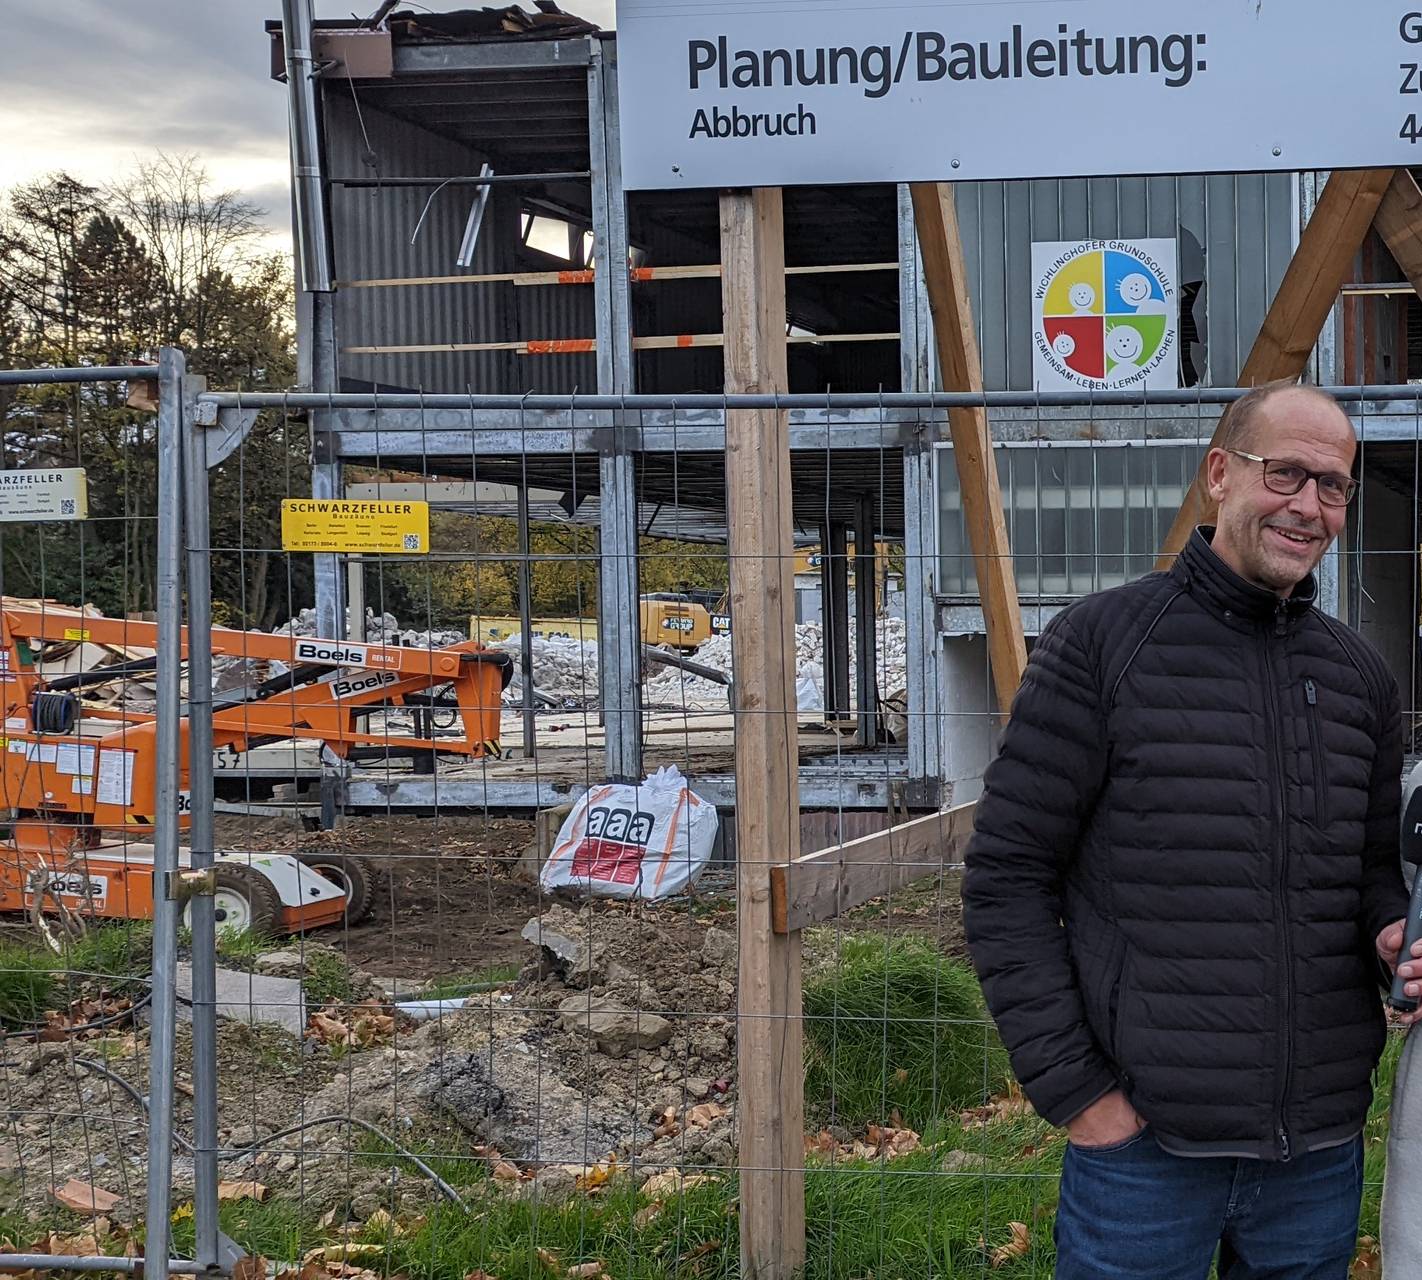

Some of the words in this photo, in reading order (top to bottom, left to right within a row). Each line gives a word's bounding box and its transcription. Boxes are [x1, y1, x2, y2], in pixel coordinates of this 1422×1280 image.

[688, 24, 1207, 98] Planung/Bauleitung:
[689, 103, 816, 138] Abbruch
[1035, 240, 1106, 299] WICHLINGHOFER
[1109, 240, 1174, 297] GRUNDSCHULE
[290, 503, 412, 514] SCHWARZFELLER
[713, 616, 730, 629] CAT
[299, 645, 363, 663] Boels
[332, 672, 395, 697] Boels
[588, 810, 651, 842] aaa
